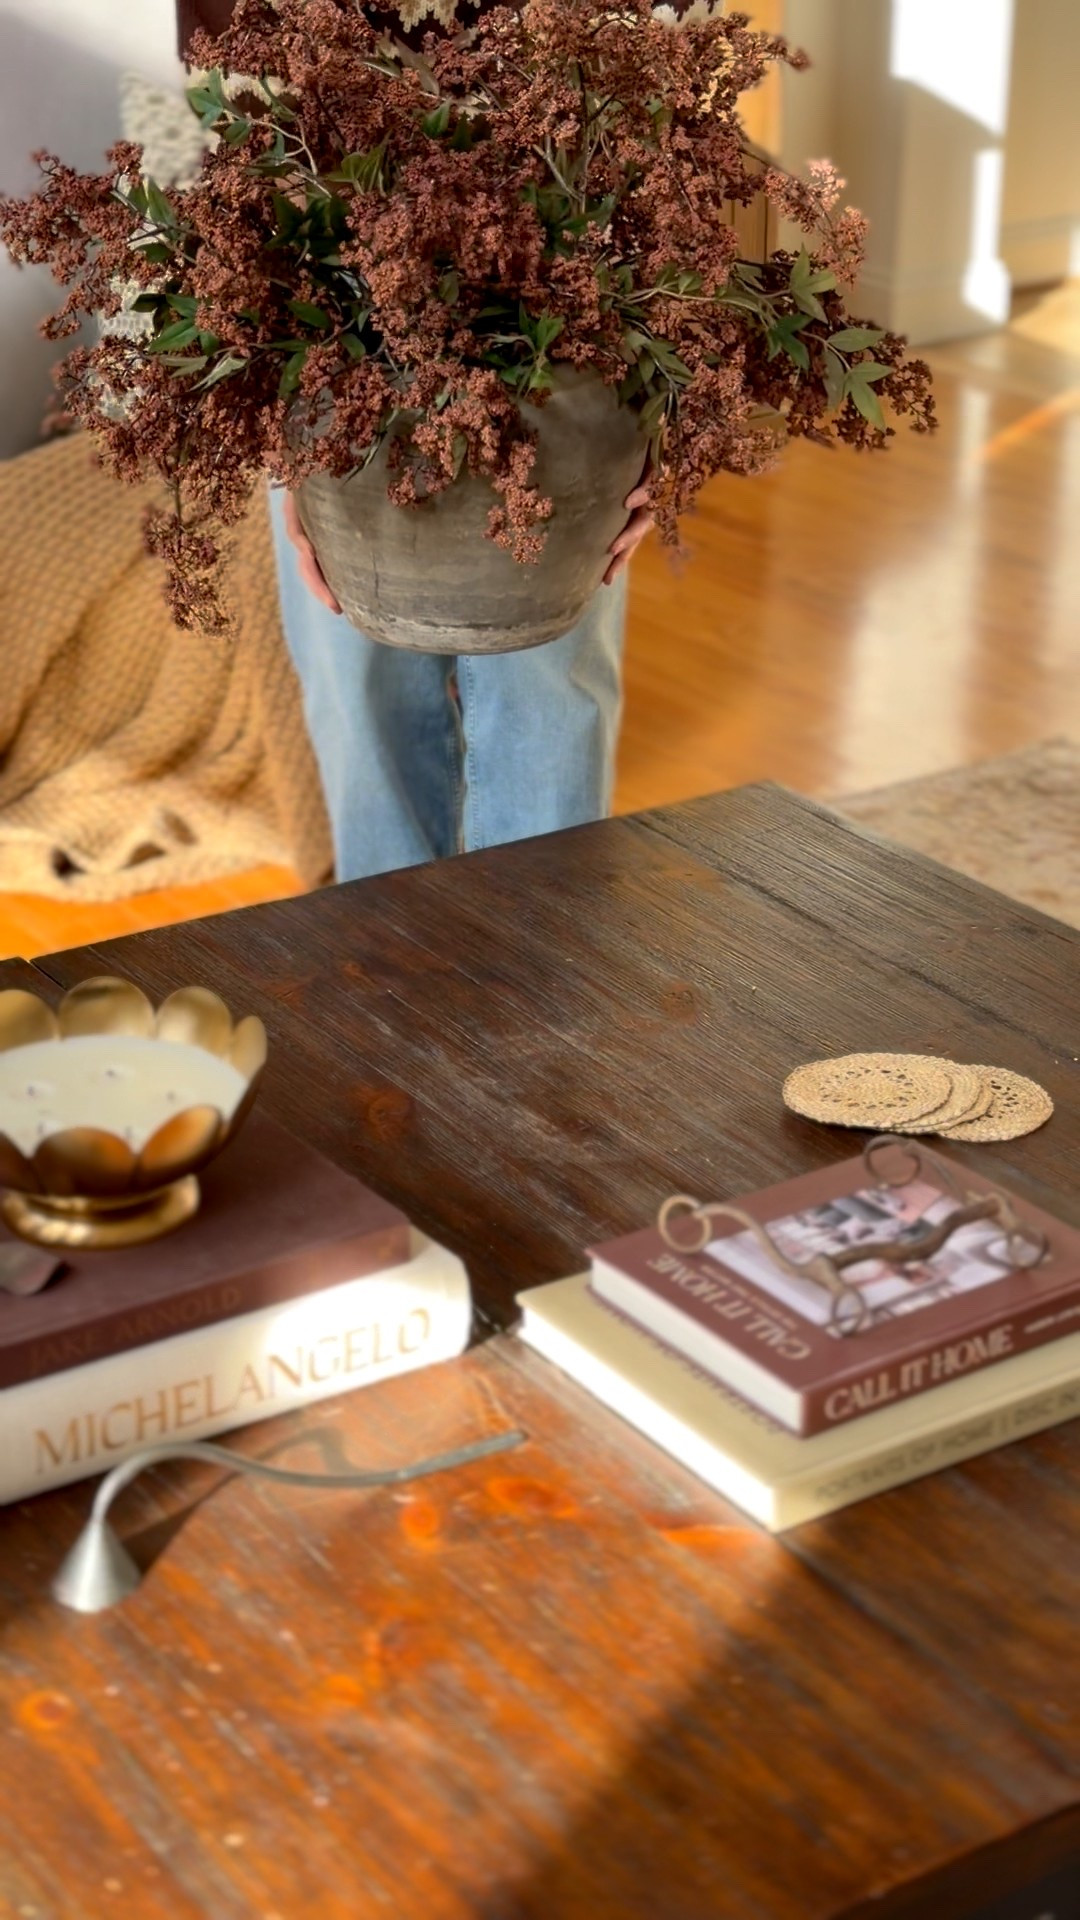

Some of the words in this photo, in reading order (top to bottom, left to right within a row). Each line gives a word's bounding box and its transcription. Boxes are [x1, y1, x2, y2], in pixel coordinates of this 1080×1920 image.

[647, 1252, 728, 1304] HOME
[711, 1298, 752, 1321] IT
[29, 1333, 96, 1374] JAKE
[114, 1286, 242, 1342] ARNOLD
[744, 1312, 812, 1360] CALL
[34, 1307, 431, 1474] MICHELANGELO
[823, 1371, 898, 1421] CALL
[900, 1356, 930, 1393] IT
[930, 1323, 1014, 1379] HOME
